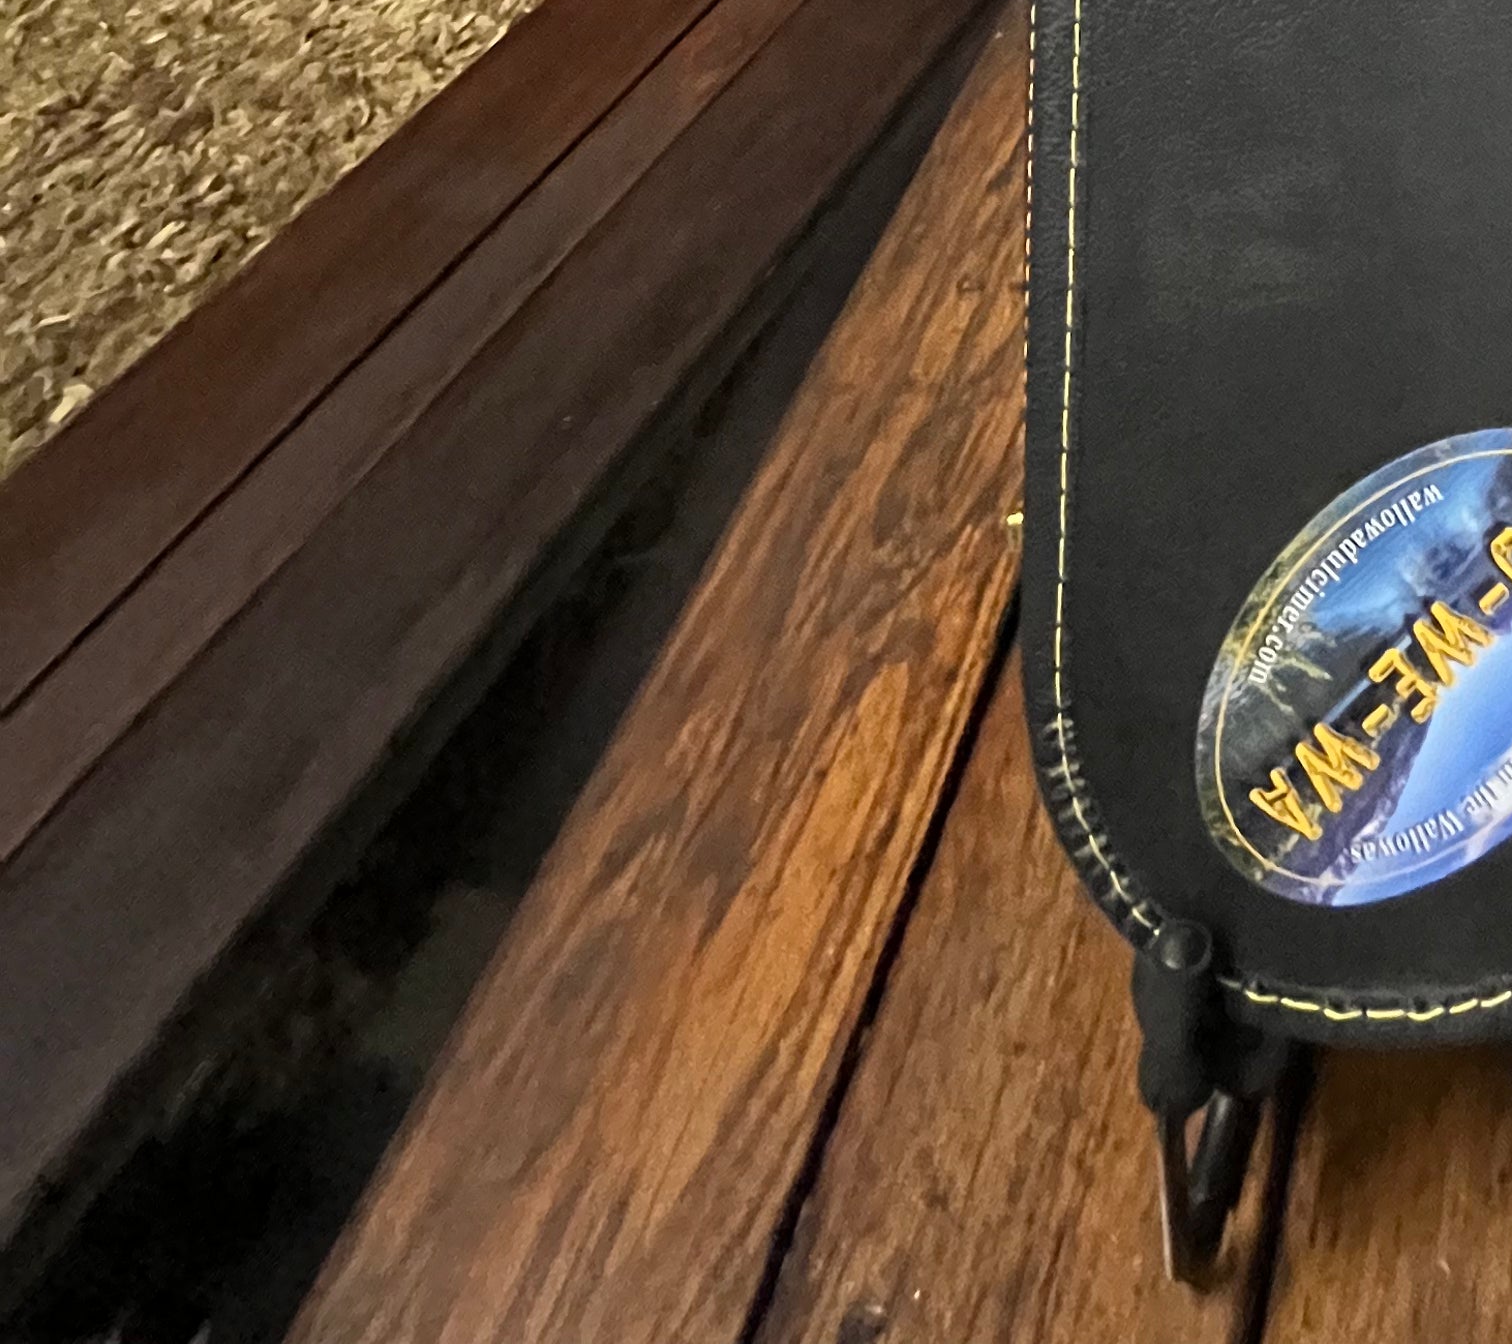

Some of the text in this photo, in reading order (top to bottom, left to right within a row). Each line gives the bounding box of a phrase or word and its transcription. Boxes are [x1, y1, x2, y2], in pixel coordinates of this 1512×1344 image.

[1249, 484, 1444, 685] wallowadulcimer.com
[1462, 775, 1509, 827] the
[1349, 808, 1464, 865] Wallowas
